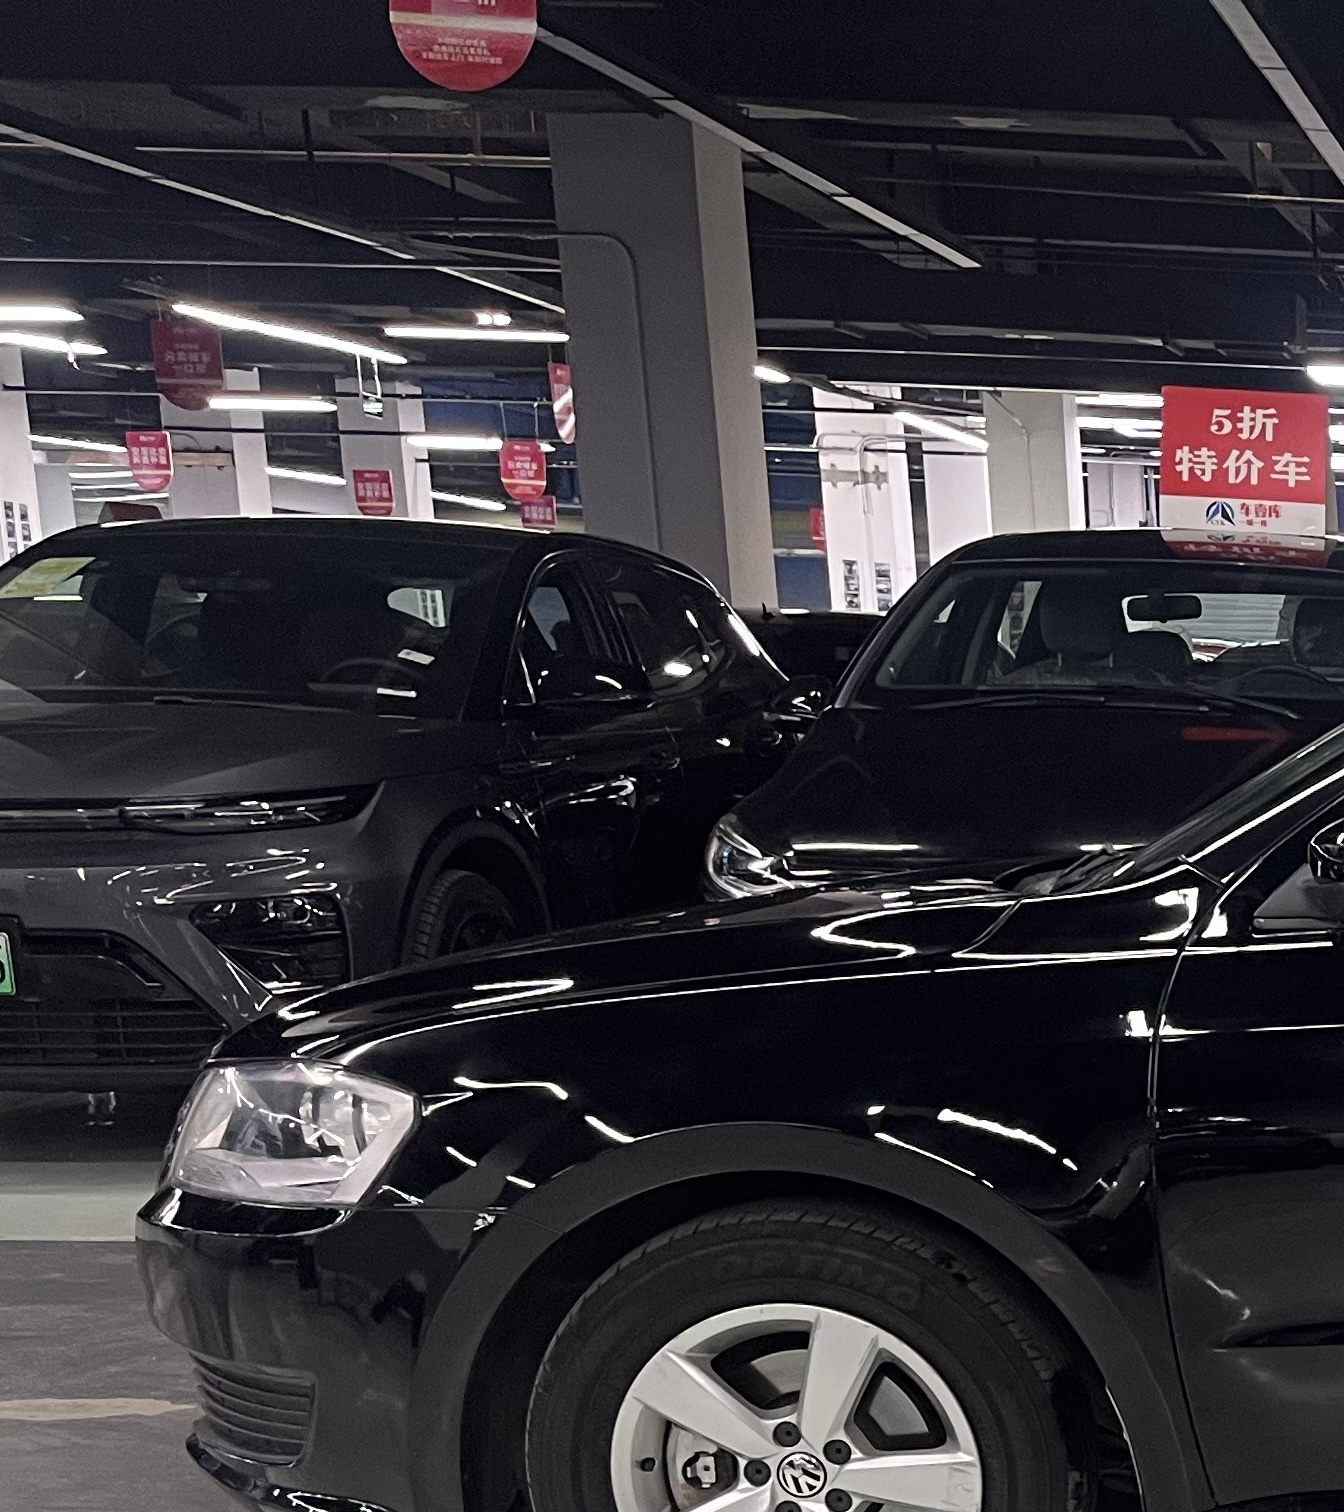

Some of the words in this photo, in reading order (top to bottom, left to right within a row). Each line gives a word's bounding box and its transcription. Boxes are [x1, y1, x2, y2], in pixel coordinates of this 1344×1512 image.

[1210, 406, 1279, 442] 5折
[1175, 445, 1312, 488] 特价车
